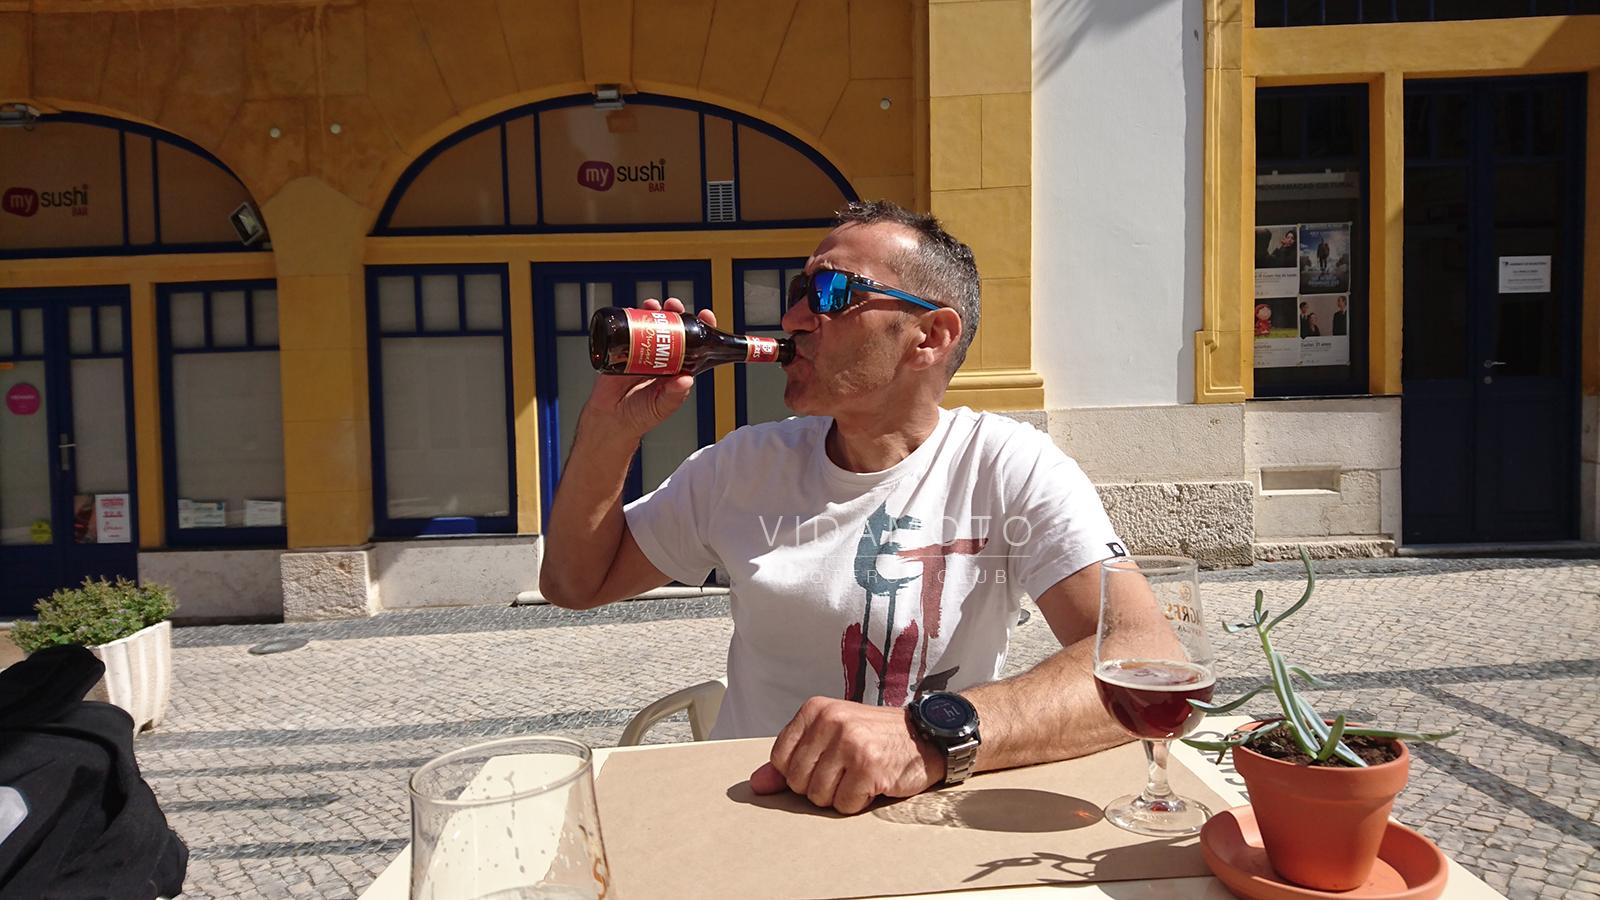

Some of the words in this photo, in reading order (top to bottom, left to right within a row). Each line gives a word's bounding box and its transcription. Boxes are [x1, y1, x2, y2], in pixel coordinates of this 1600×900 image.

[585, 168, 609, 187] my
[616, 158, 666, 182] sushi
[10, 194, 33, 212] my
[40, 184, 88, 207] sushi
[648, 183, 665, 192] BAR
[641, 328, 656, 366] Original
[652, 312, 671, 369] BOHEMIA
